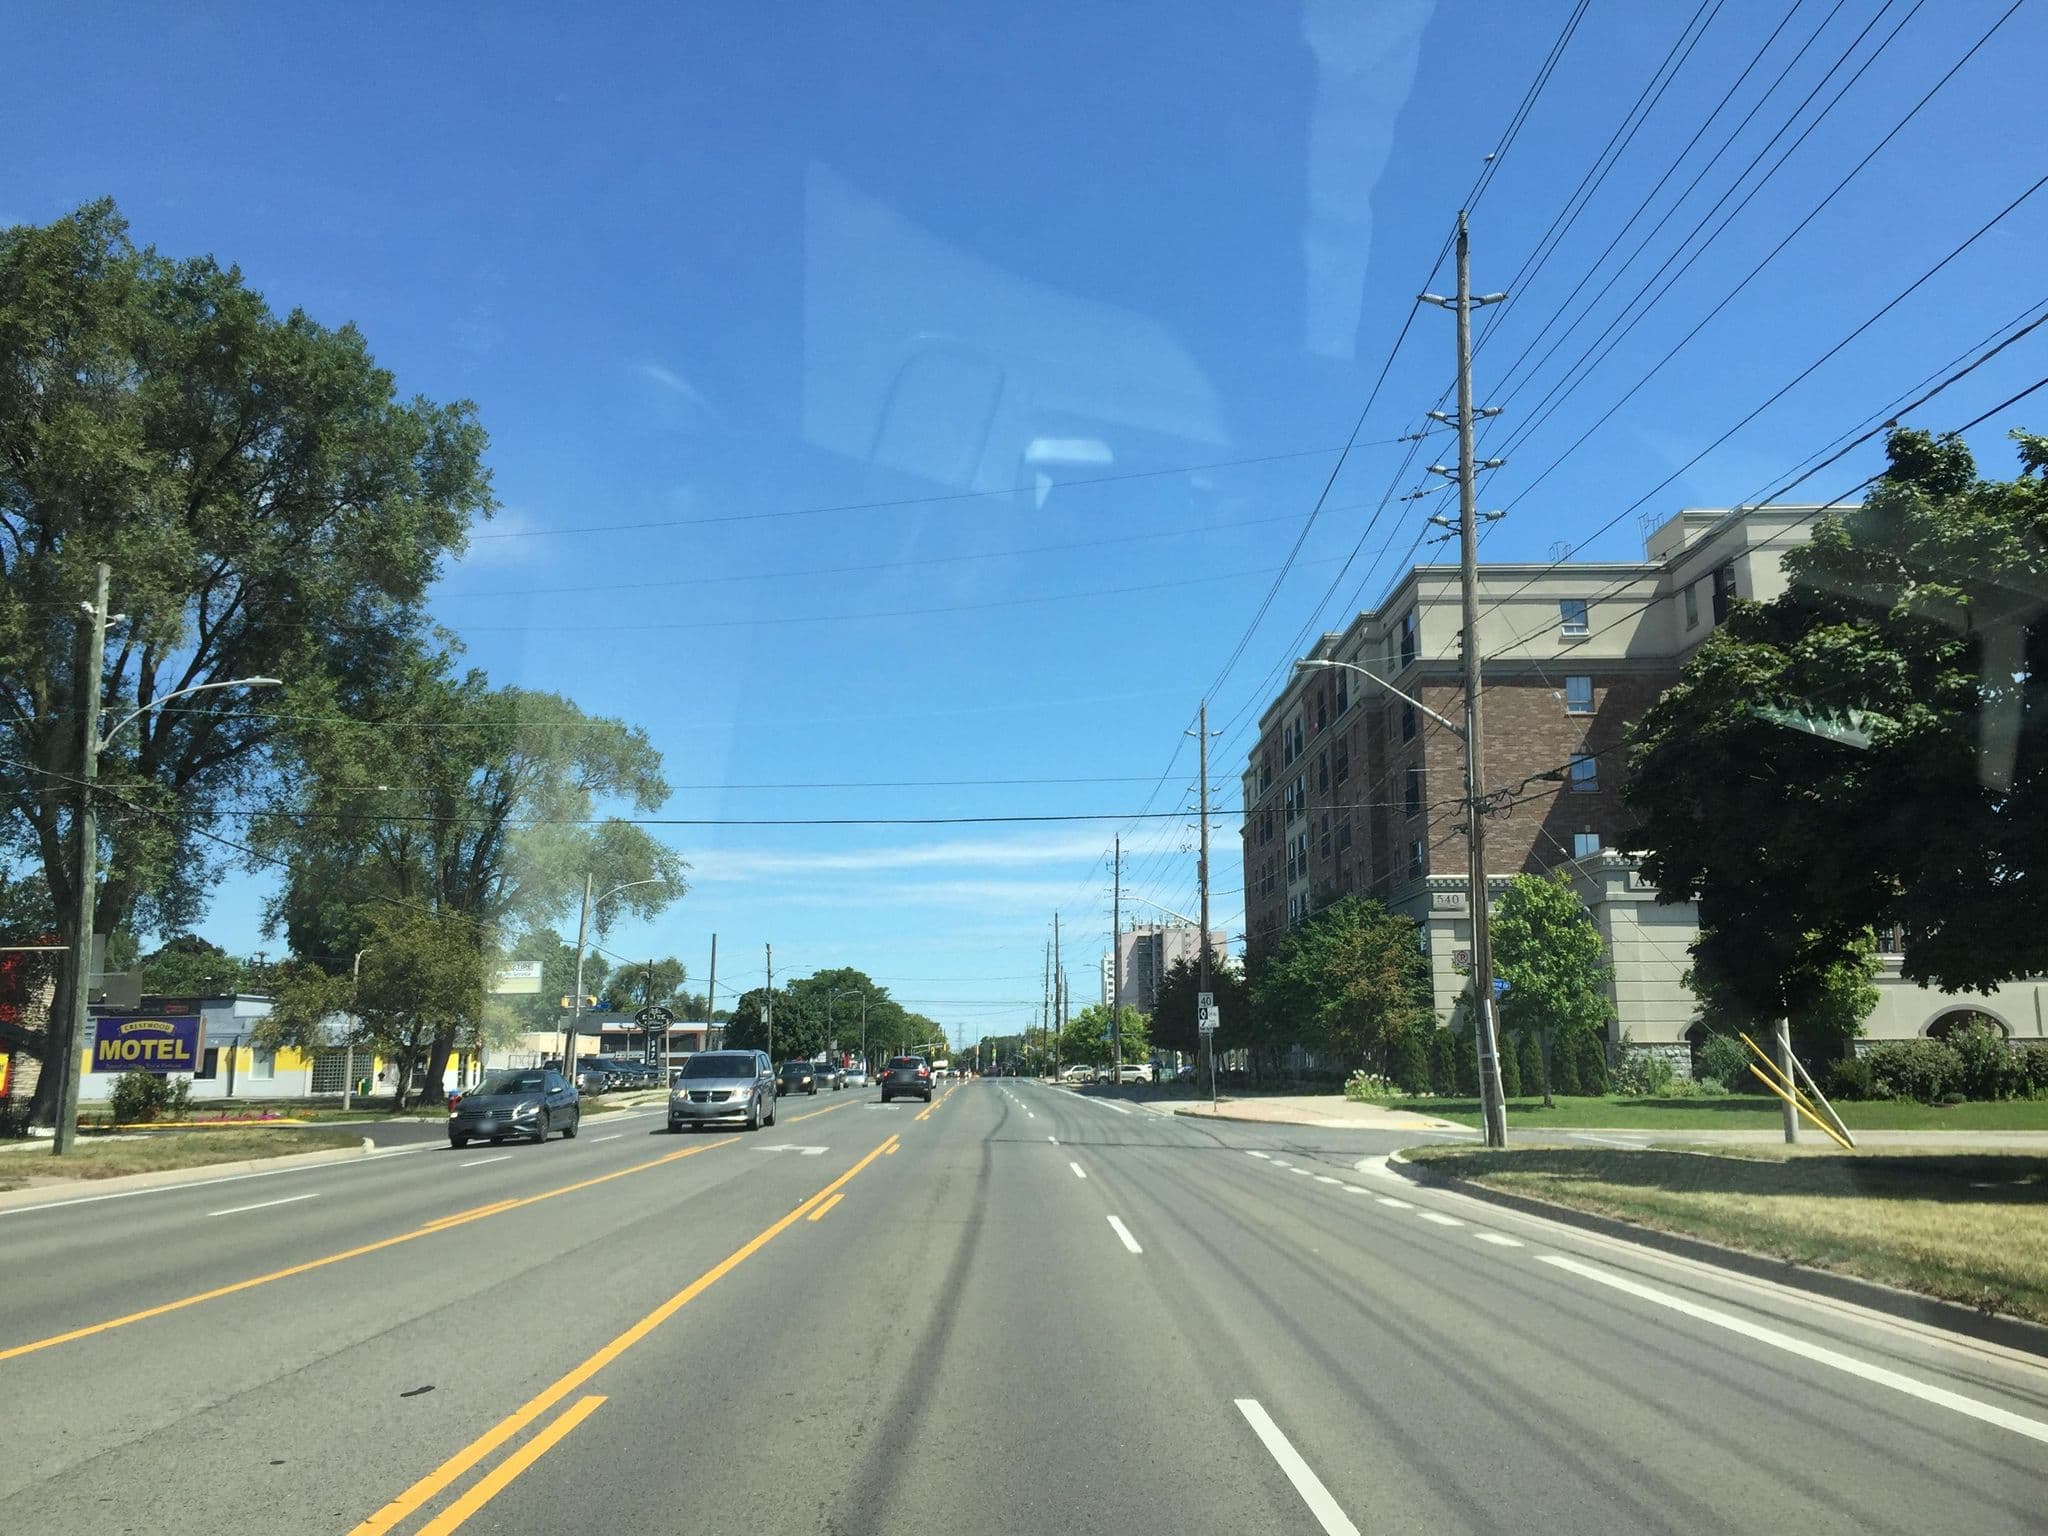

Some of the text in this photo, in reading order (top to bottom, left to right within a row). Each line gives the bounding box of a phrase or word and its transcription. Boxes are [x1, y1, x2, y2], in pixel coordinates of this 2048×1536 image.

[1437, 895, 1460, 904] 540
[1200, 996, 1212, 1006] 40
[99, 1040, 190, 1060] MOTEL
